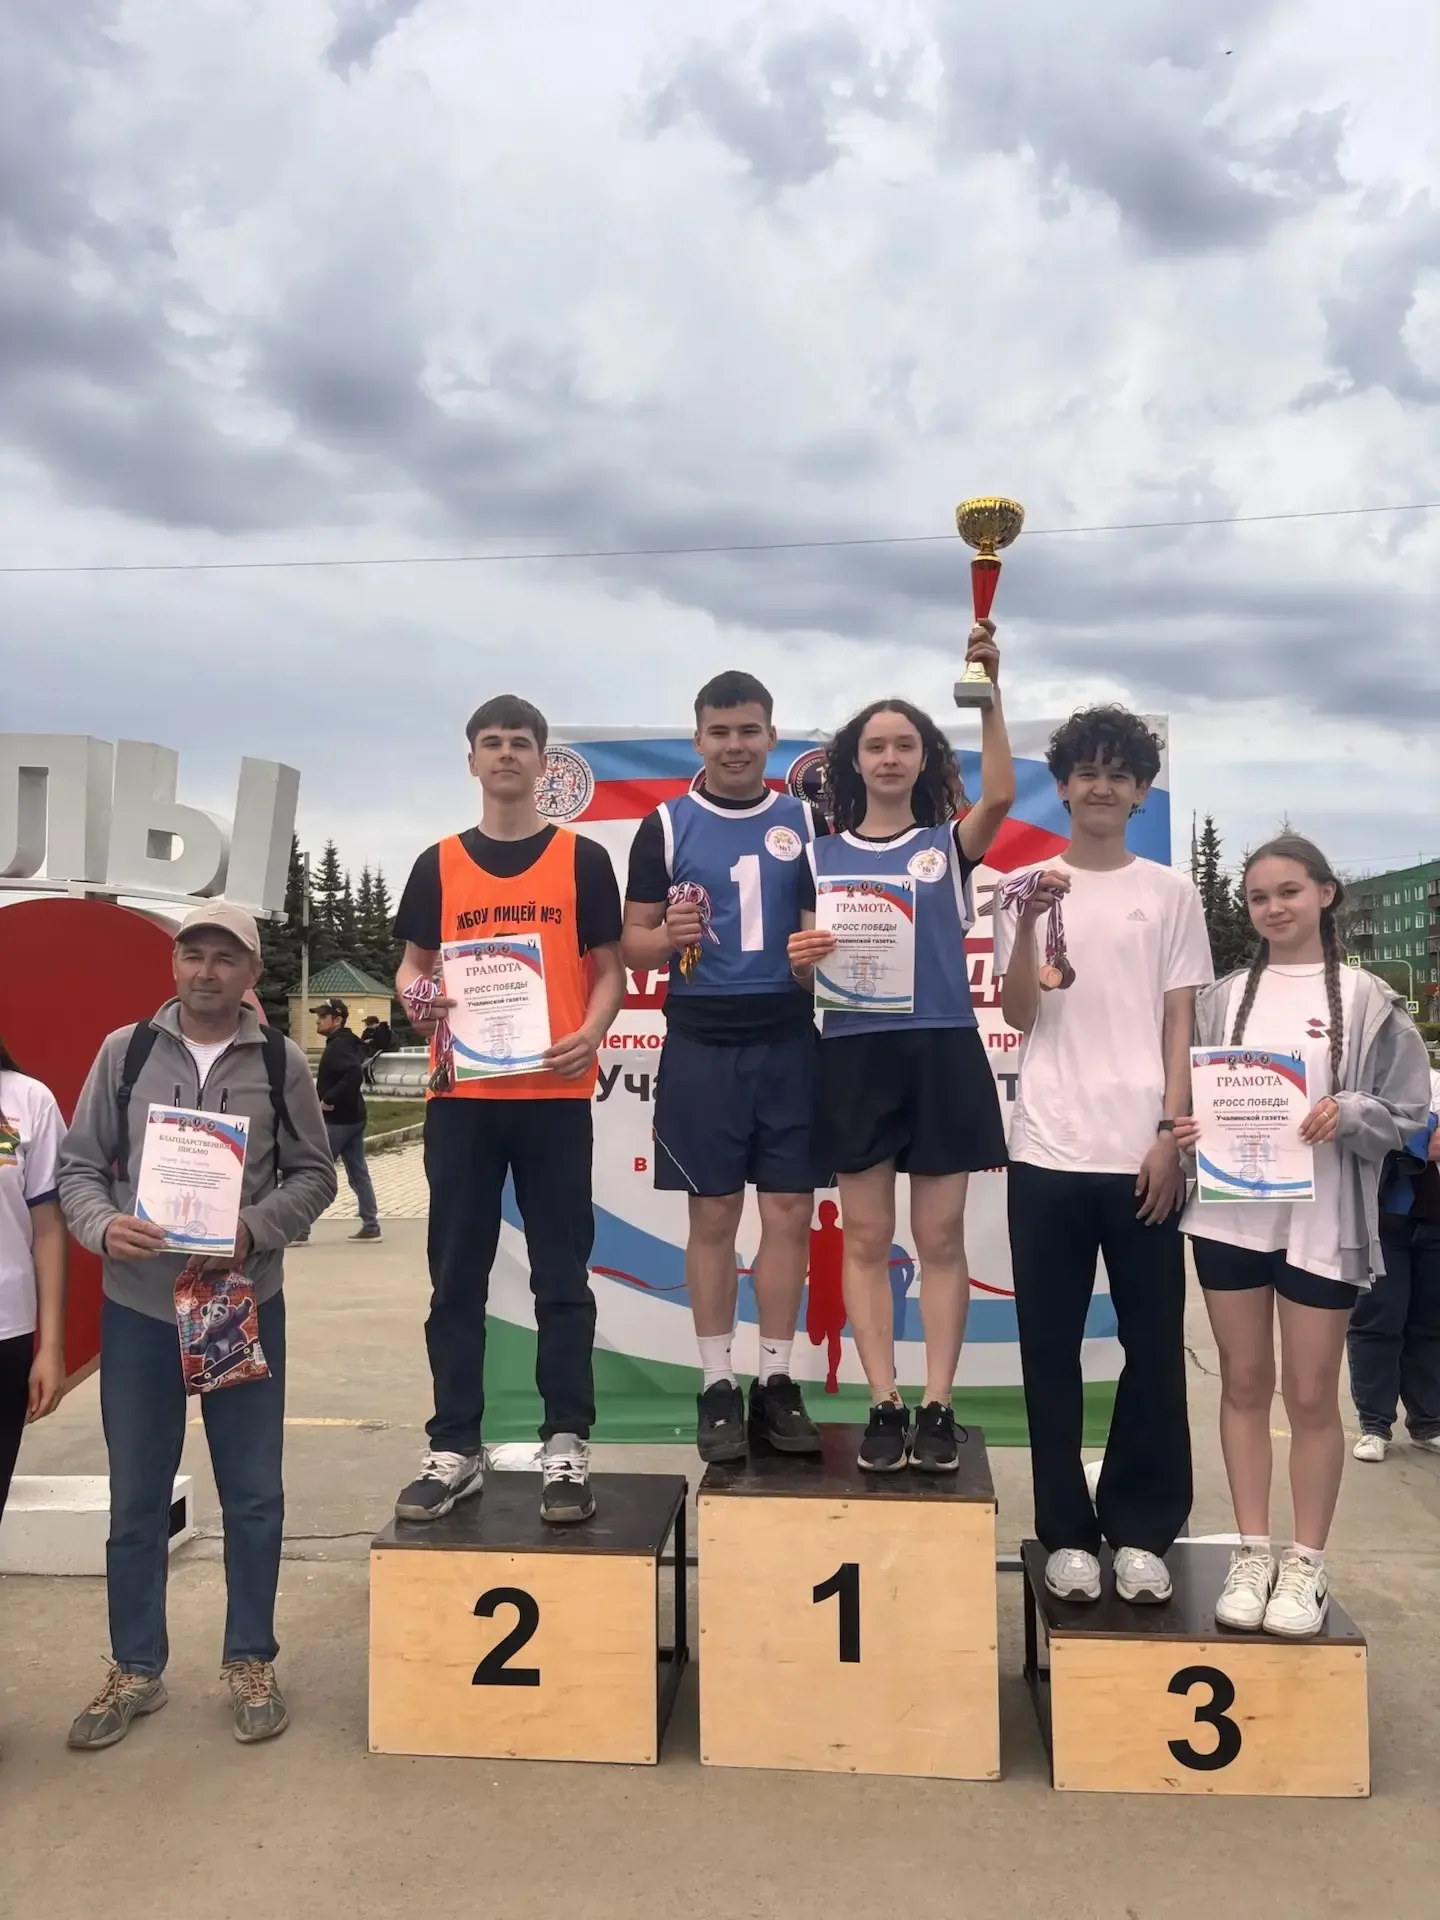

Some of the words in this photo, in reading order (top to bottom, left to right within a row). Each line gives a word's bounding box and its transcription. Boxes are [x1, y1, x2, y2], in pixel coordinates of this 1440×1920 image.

[730, 854, 764, 952] 1
[835, 902, 894, 914] ГРАМОТА
[540, 905, 563, 925] №3
[831, 923, 860, 932] КРОСС
[861, 923, 898, 932] ПОБЕДЫ
[465, 962, 522, 977] ГРАМОТА
[463, 984, 492, 996] КРОСС
[492, 980, 528, 992] ПОБЕДЫ
[1216, 1074, 1283, 1088] ГРАМОТА
[1212, 1098, 1245, 1107] КРОСС
[1247, 1097, 1289, 1107] ПОБЕДЫ
[177, 1145, 209, 1156] ПИСЬМО
[811, 1562, 861, 1664] 1
[471, 1586, 541, 1687] 2
[1165, 1665, 1243, 1771] 3
